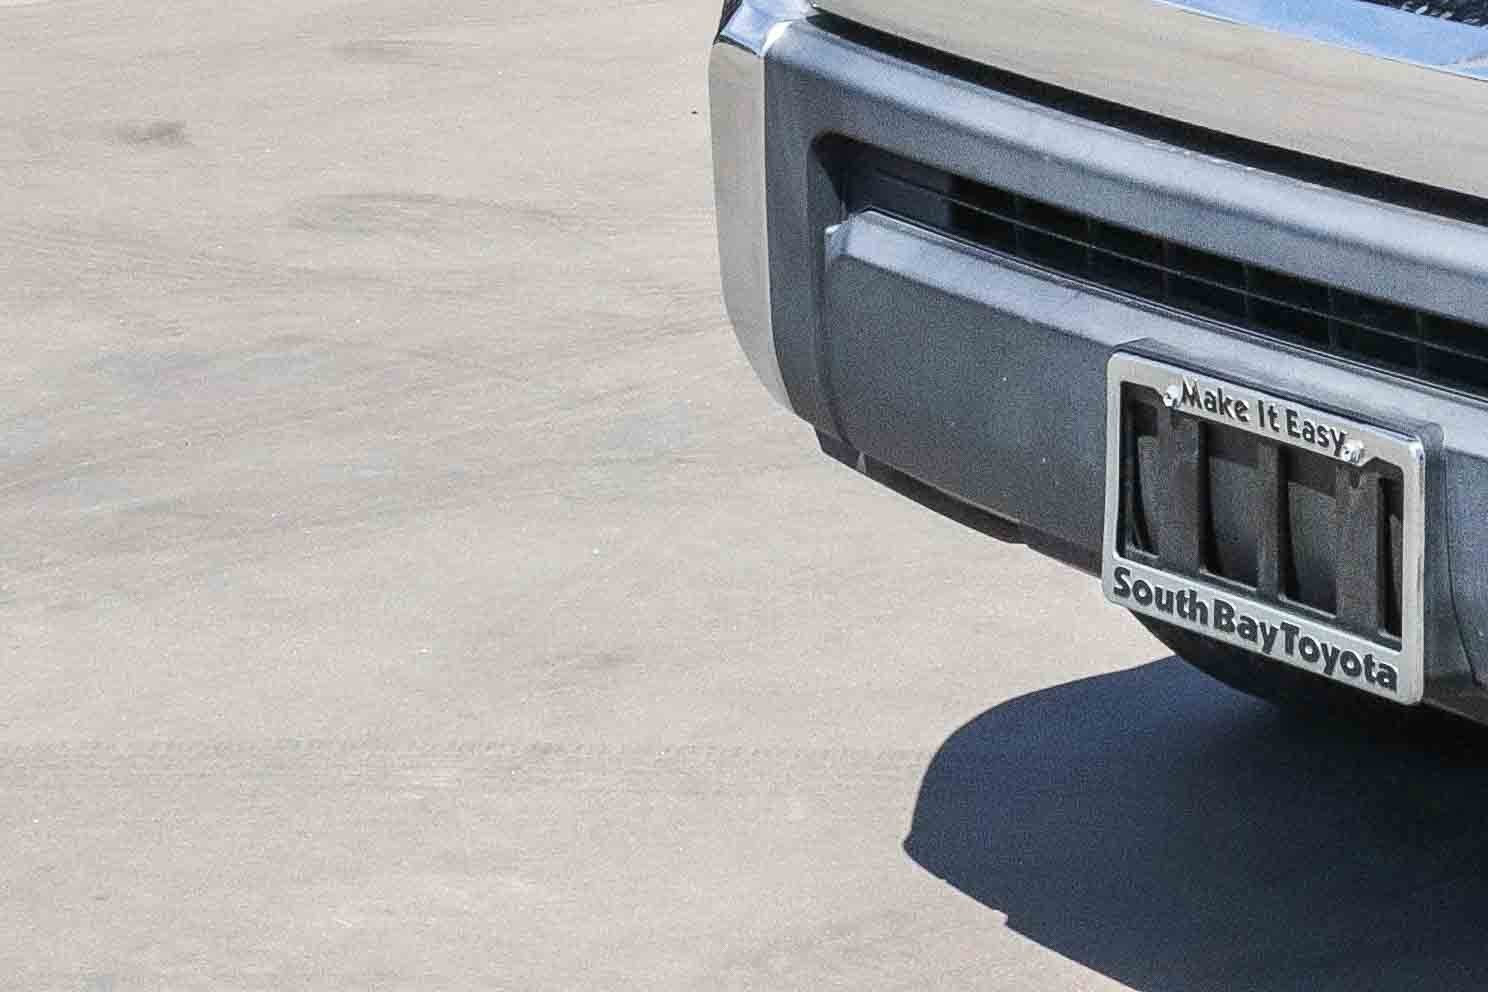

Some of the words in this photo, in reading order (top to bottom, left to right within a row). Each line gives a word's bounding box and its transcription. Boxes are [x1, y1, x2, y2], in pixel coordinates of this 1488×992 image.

[1181, 378, 1249, 423] Make
[1257, 399, 1281, 433] It
[1285, 408, 1347, 457] Easy
[1113, 565, 1209, 626] South
[1213, 599, 1279, 655] Bay
[1279, 621, 1399, 693] Toyota
